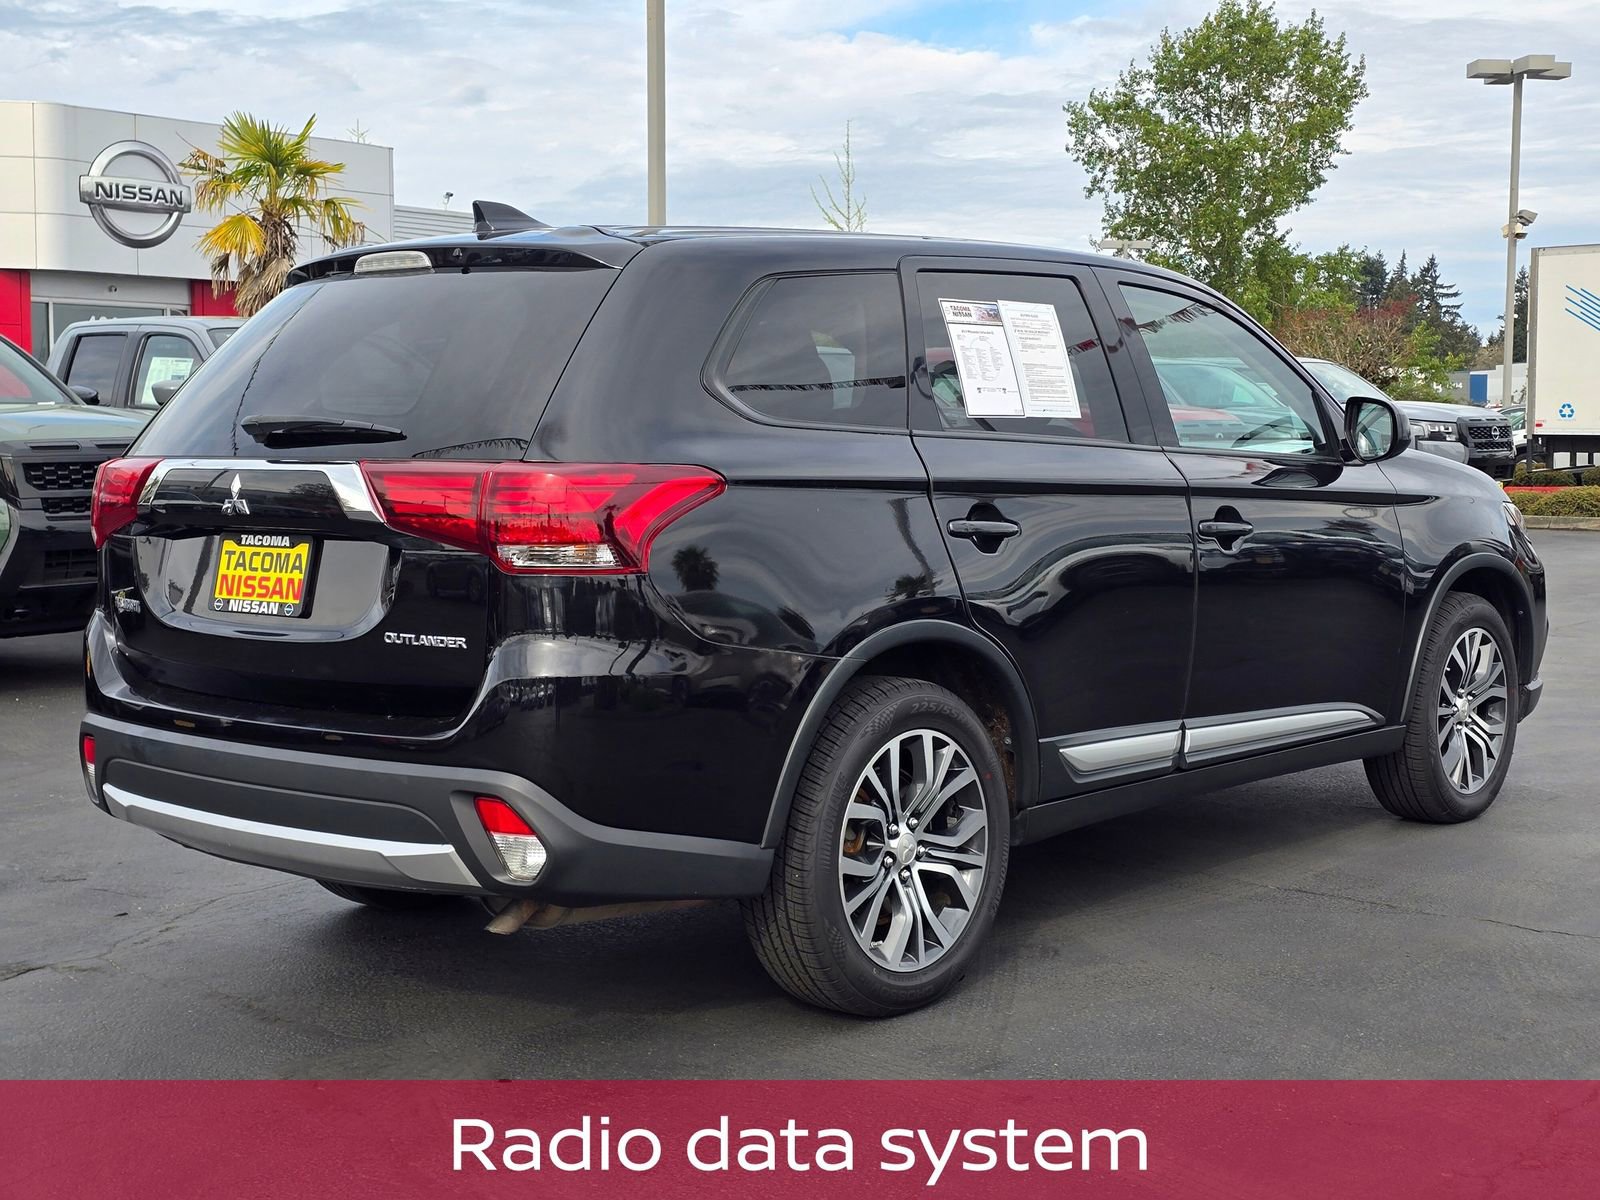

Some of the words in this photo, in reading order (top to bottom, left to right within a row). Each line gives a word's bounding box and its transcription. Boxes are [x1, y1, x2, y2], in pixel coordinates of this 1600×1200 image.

[95, 181, 183, 206] NISSAN
[241, 534, 290, 547] TACOMA
[225, 550, 304, 574] TACOMA
[218, 574, 304, 601] NISSAN
[228, 599, 279, 615] NISSAN
[384, 631, 468, 649] OUTLANDER
